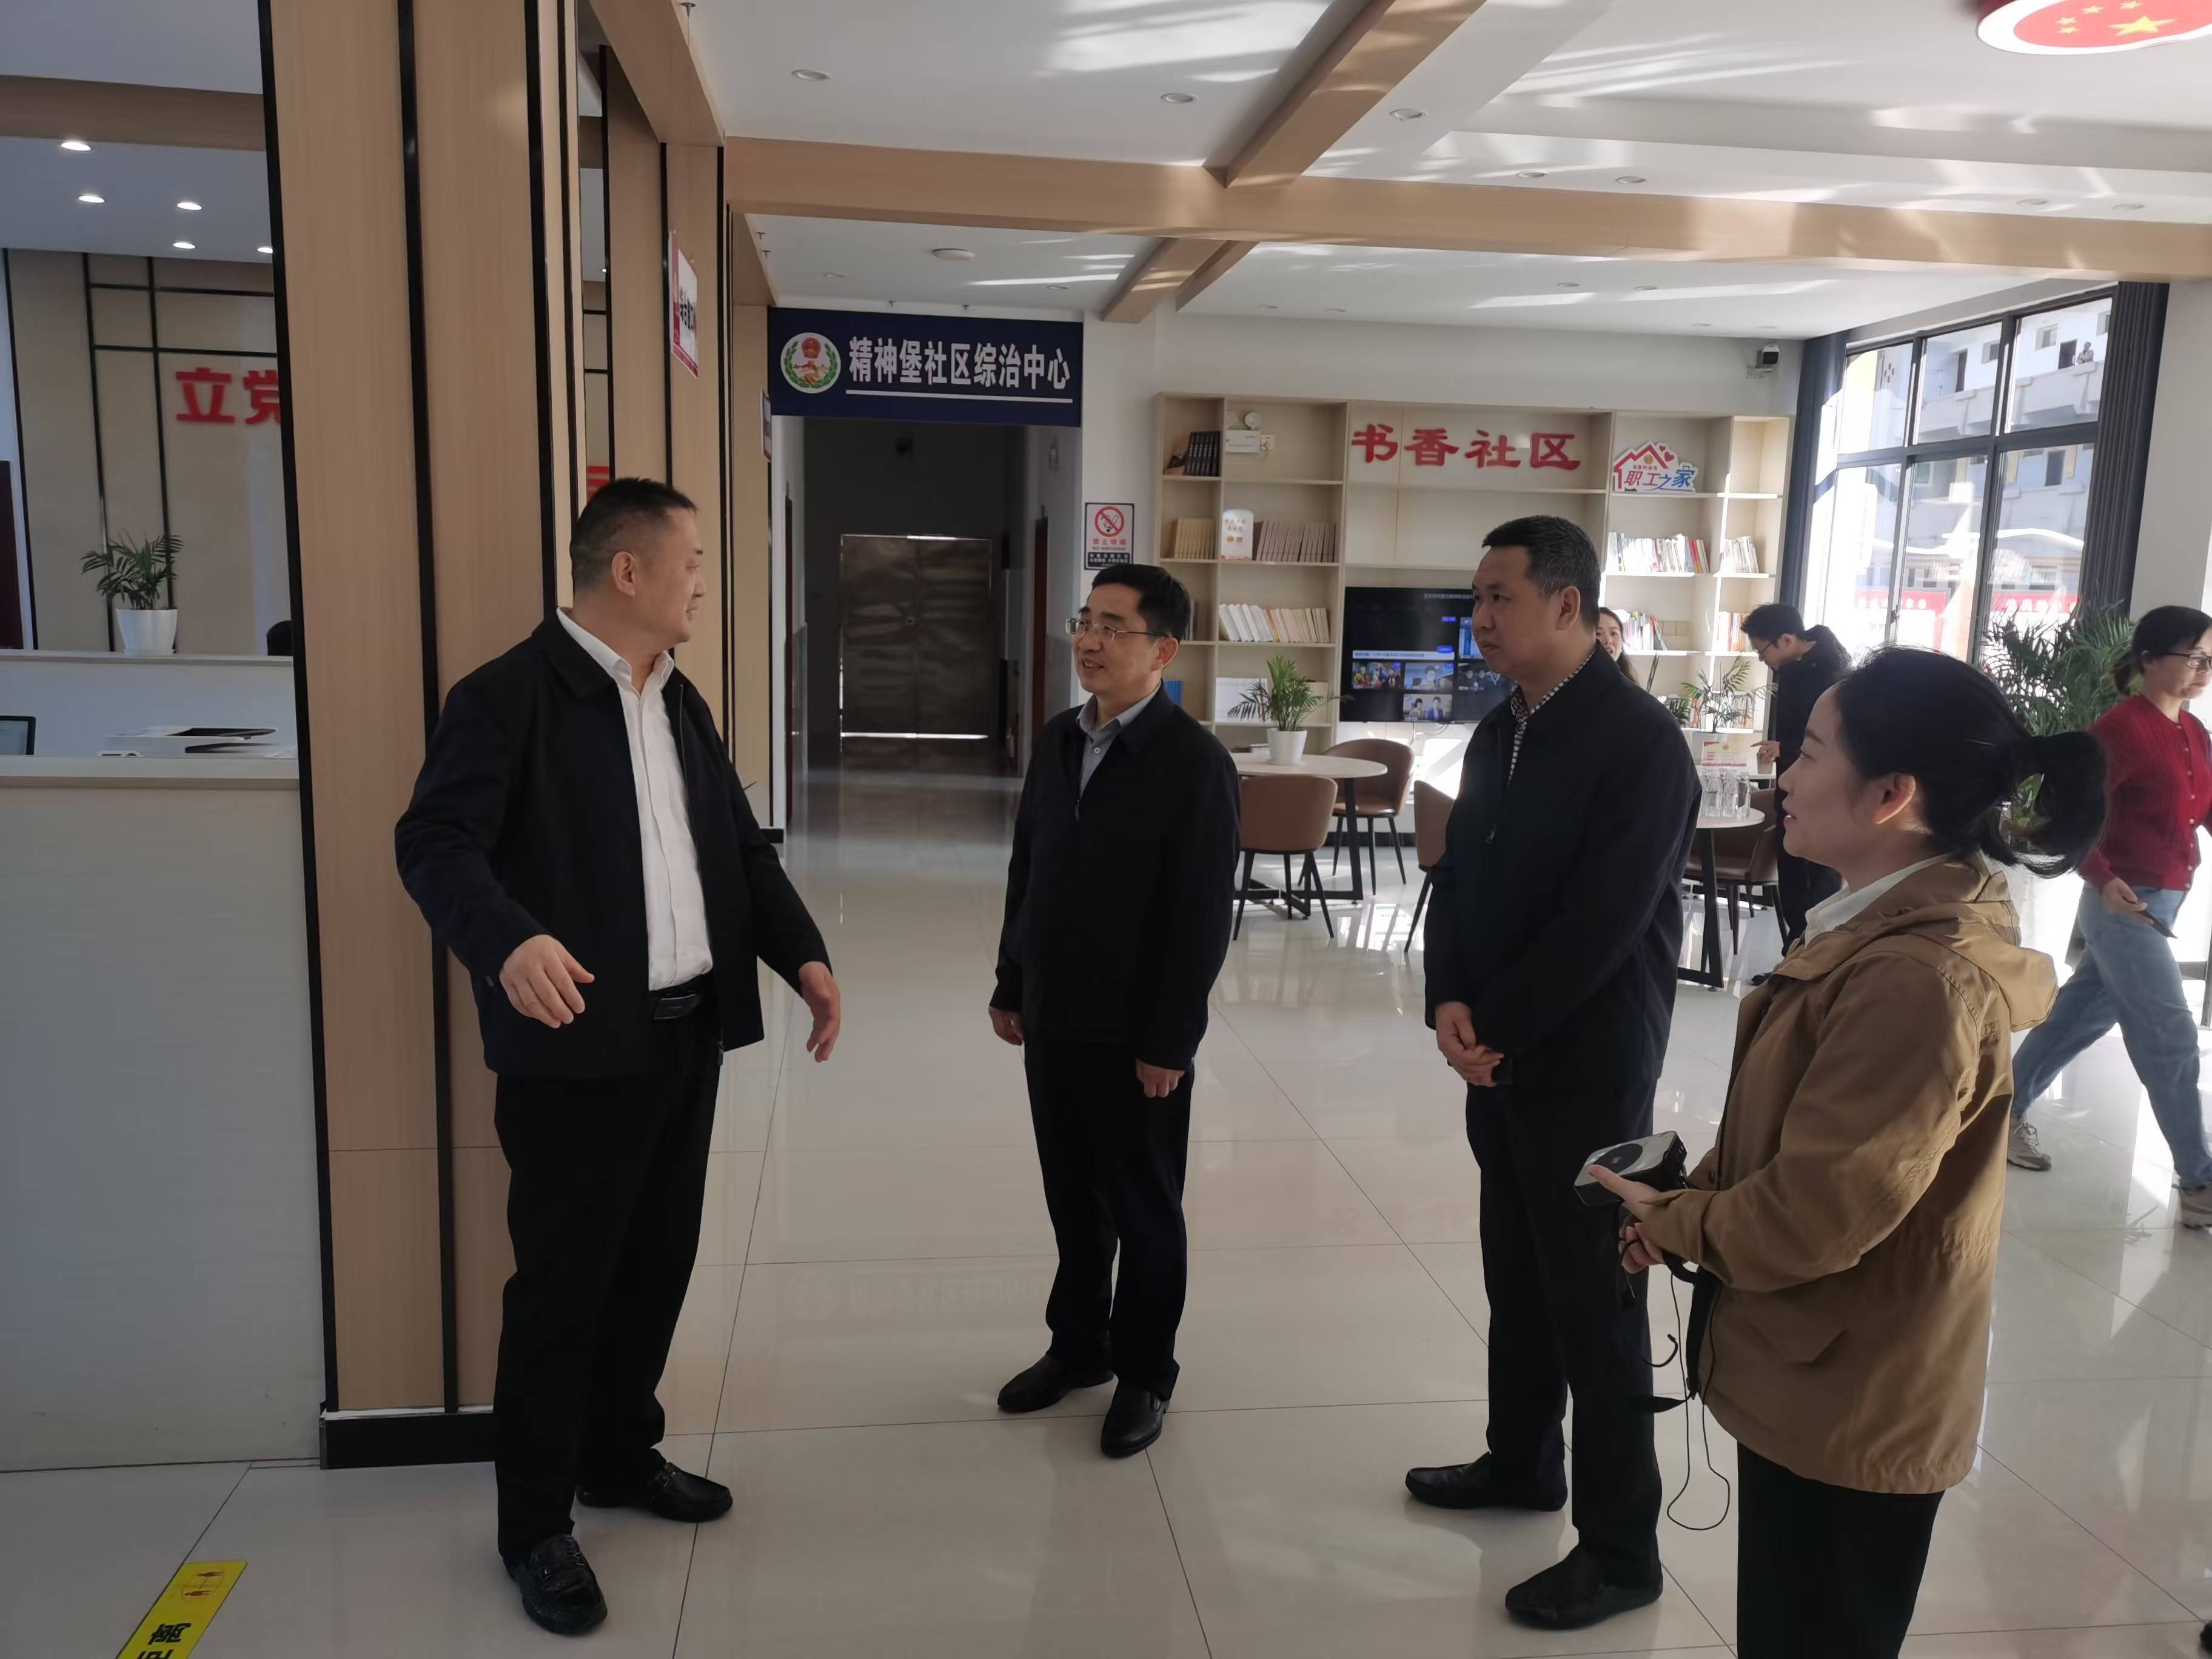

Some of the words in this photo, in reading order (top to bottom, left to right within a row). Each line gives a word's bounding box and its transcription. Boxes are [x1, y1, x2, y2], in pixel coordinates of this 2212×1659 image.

[848, 336, 1071, 390] 精神堡社区综治中心
[1350, 423, 1582, 471] 书香社区
[1624, 465, 1695, 492] 职工之家
